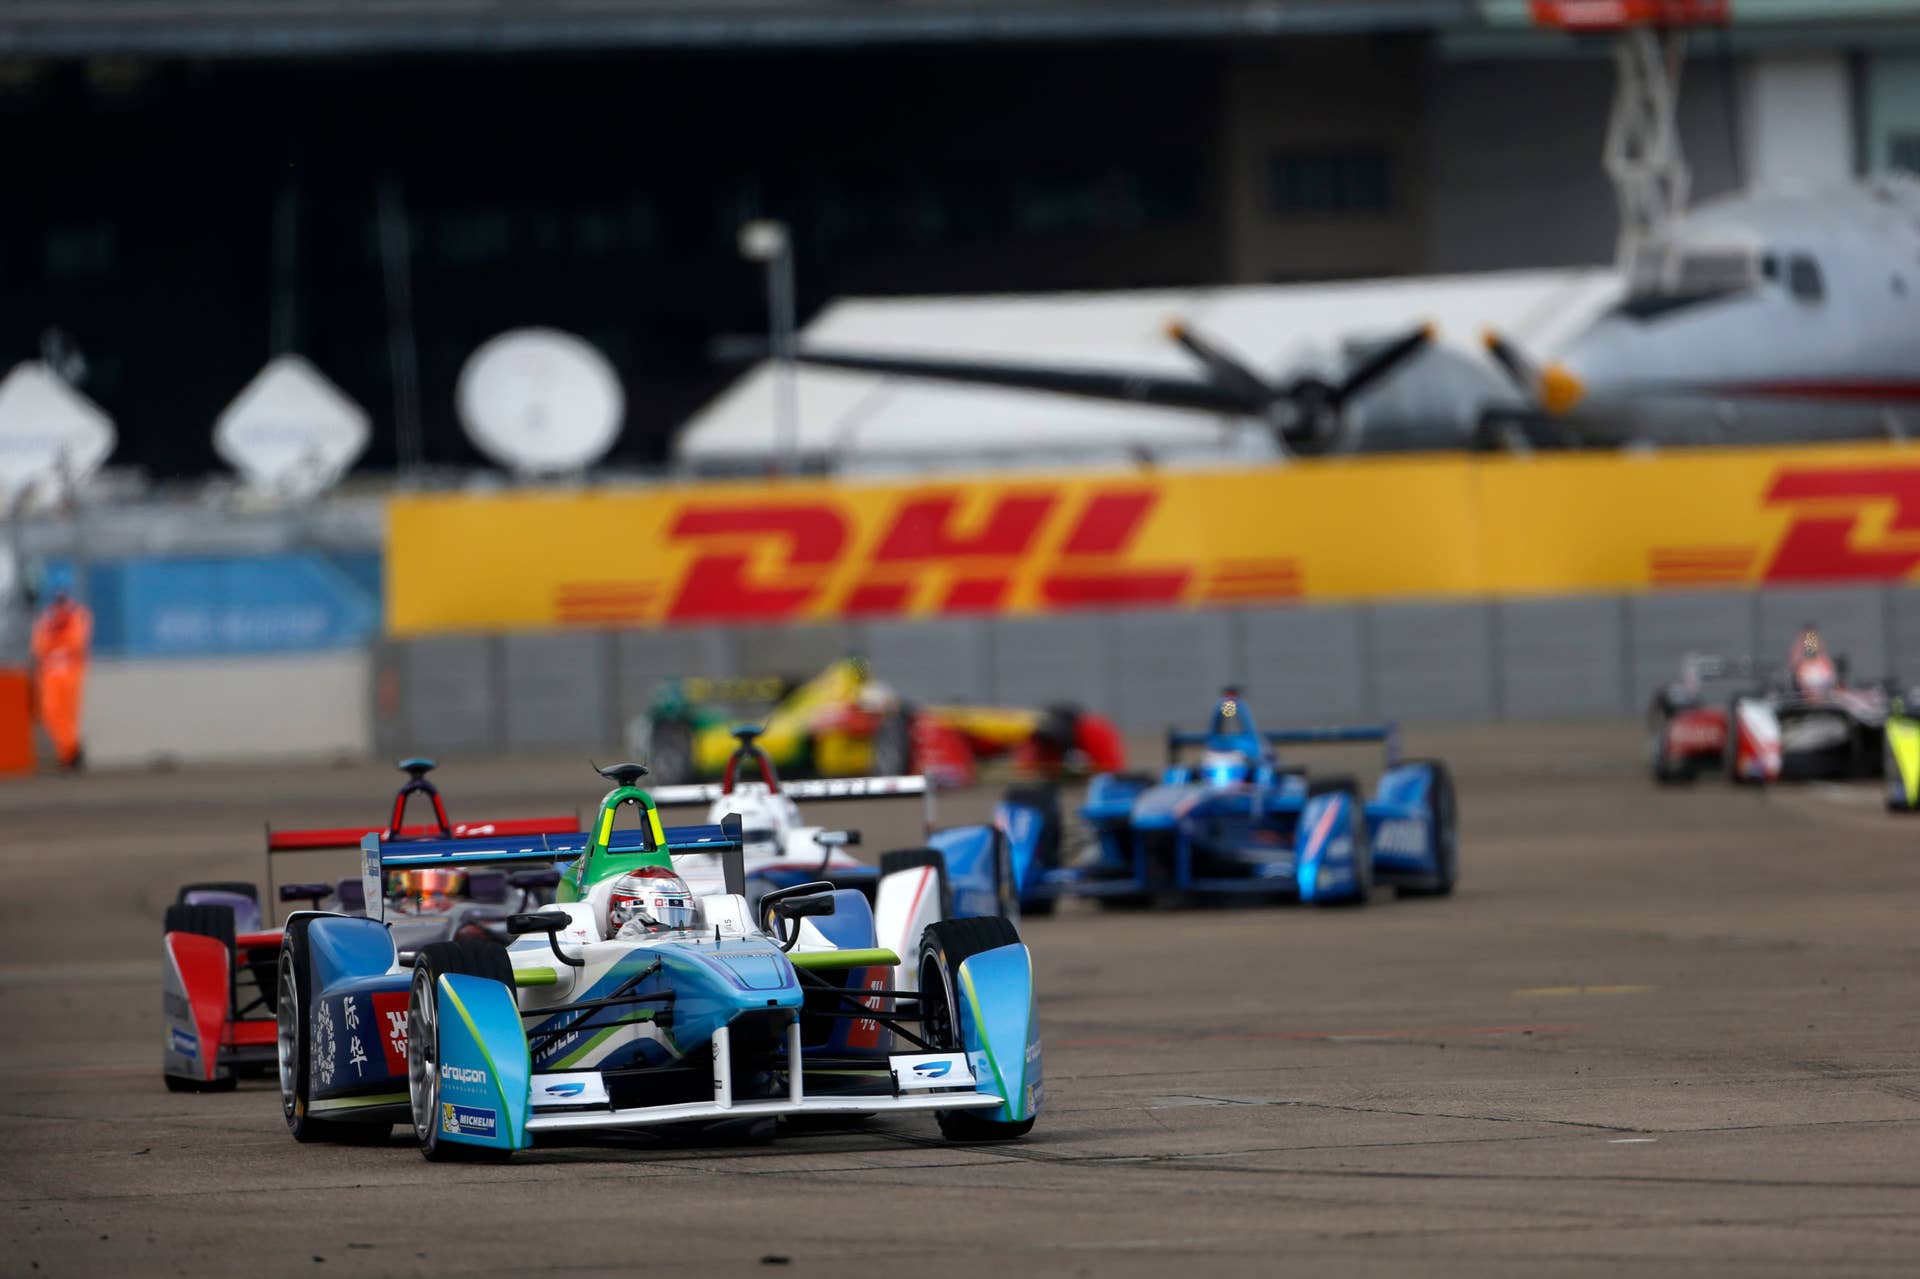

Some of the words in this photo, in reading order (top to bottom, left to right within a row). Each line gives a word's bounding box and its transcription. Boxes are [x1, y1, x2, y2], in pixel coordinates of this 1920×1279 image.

[666, 489, 1191, 623] DHL
[391, 1039, 408, 1058] 19
[441, 1063, 487, 1084] drayson
[460, 1114, 495, 1128] MICHELIN
